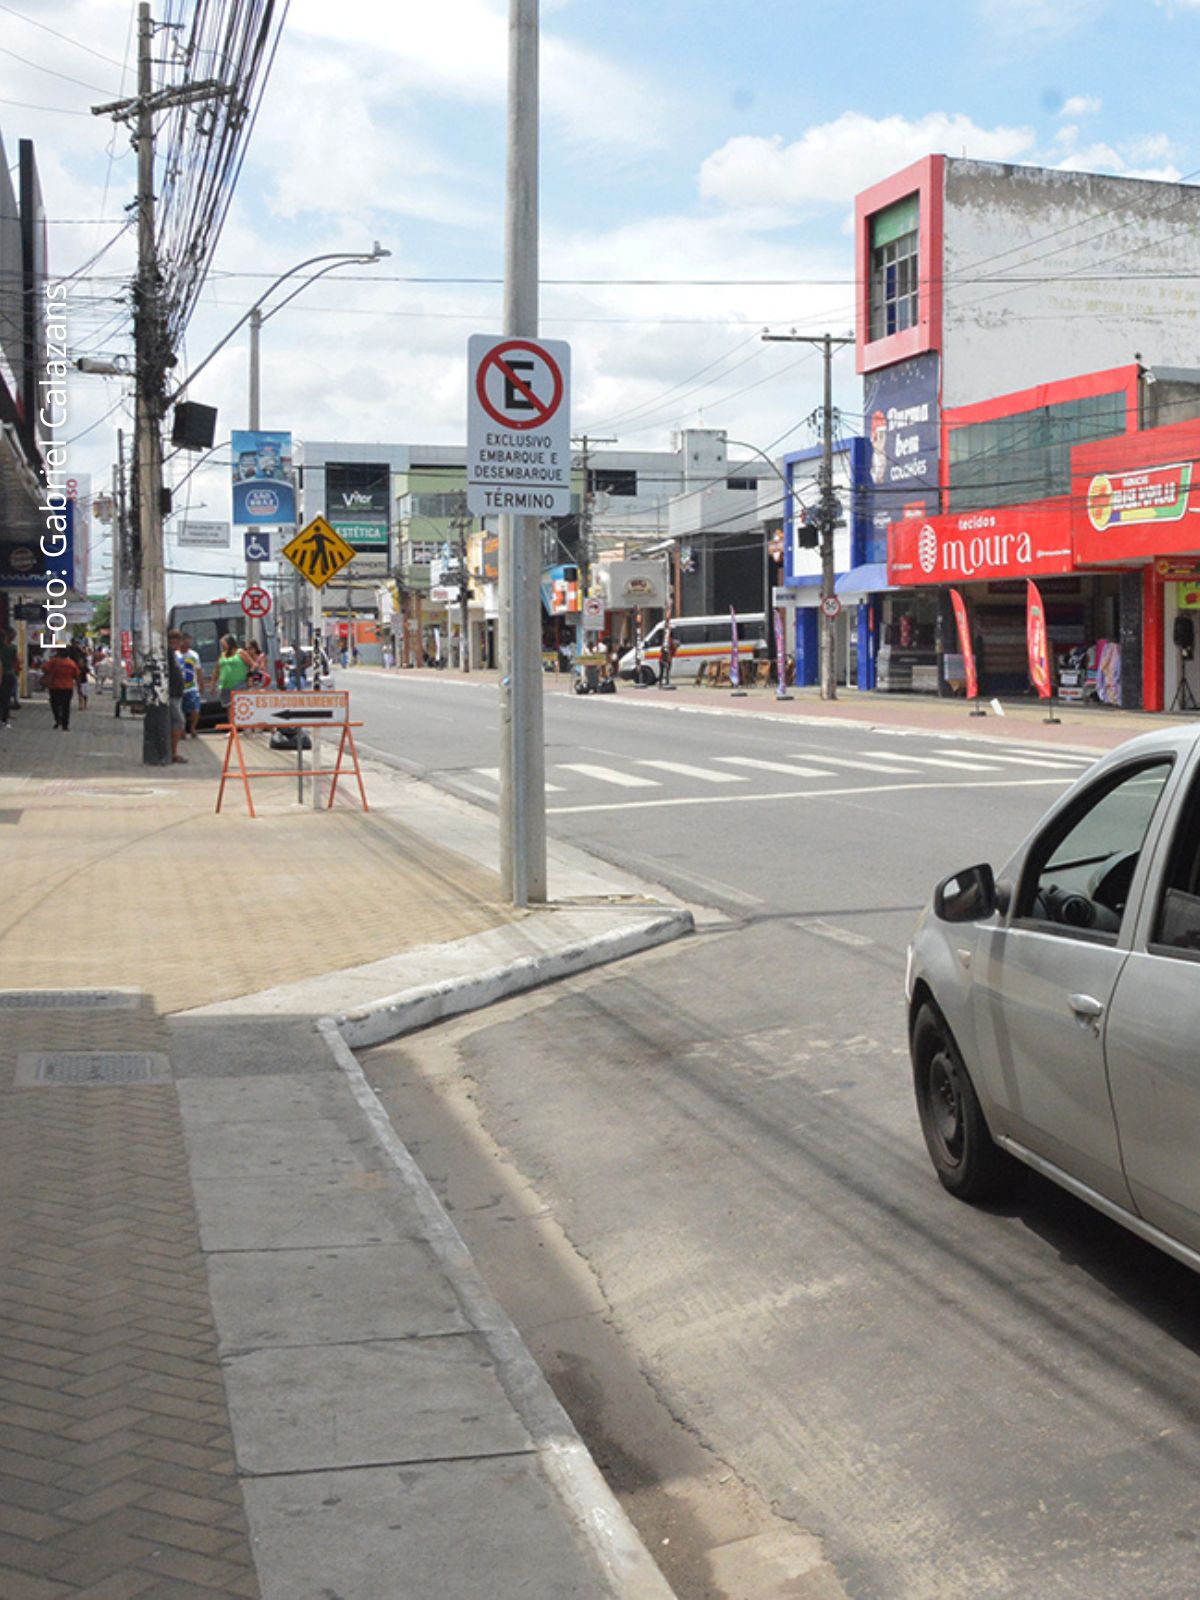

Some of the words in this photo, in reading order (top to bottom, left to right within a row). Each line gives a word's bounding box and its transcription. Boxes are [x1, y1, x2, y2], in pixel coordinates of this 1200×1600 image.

[887, 403, 929, 432] Durma
[486, 433, 552, 449] EXCLUSIVO
[895, 433, 919, 458] bem
[479, 449, 548, 466] EMBARQUE
[551, 452, 558, 465] E
[474, 465, 563, 482] DESEMBARQUE
[484, 487, 555, 510] TÉRMINO
[958, 515, 996, 531] tecidos
[335, 525, 381, 539] ESTÉTICA
[942, 531, 1033, 576] moura
